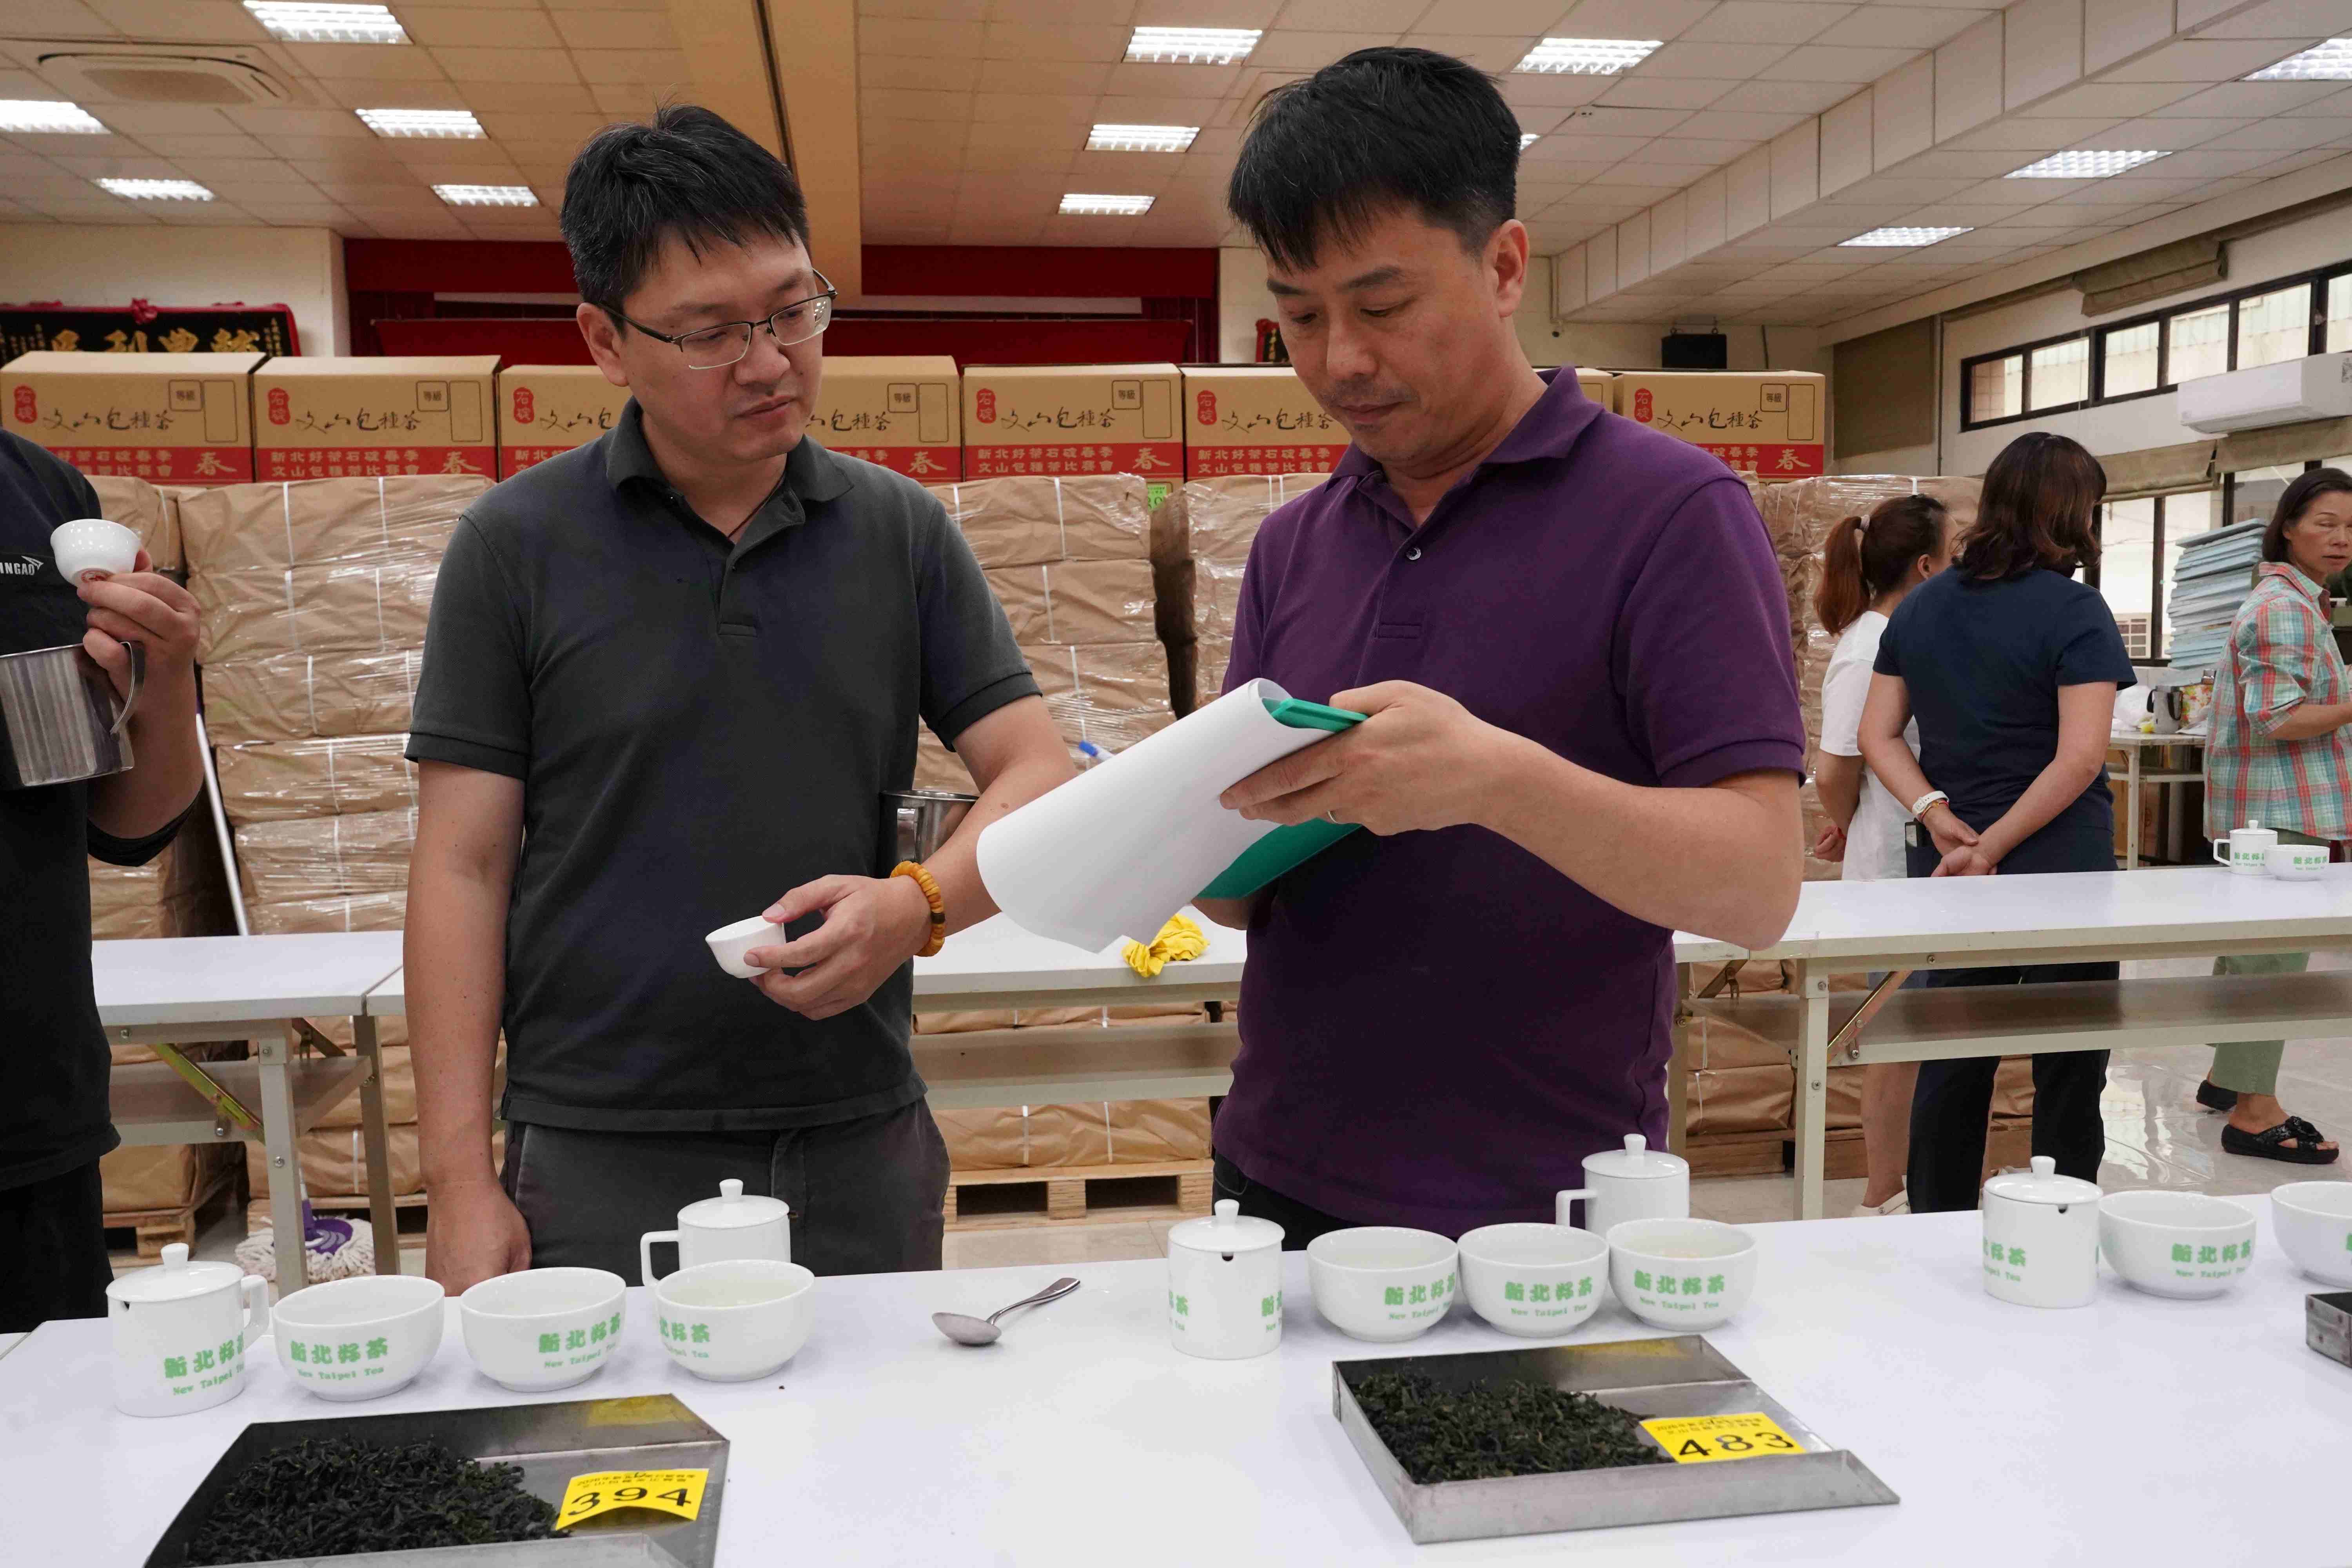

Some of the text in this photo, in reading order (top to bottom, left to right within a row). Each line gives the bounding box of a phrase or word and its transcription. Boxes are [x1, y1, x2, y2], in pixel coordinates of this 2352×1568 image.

[516, 392, 531, 421] 石碇
[978, 391, 995, 421] 石碇
[1200, 393, 1214, 422] 石碇
[1637, 392, 1650, 419] 石碇
[1766, 393, 1782, 403] 等級
[196, 452, 237, 475] 春
[440, 452, 482, 474] 春
[908, 452, 946, 474] 春
[1132, 448, 1170, 470] 春
[1776, 449, 1811, 470] 春
[1505, 1276, 1592, 1302] 新北好茶
[1633, 1269, 1725, 1295] 新北好茶
[290, 1336, 388, 1365] 新北好茶
[1679, 1432, 1794, 1457] 483
[568, 1487, 692, 1516] 394
